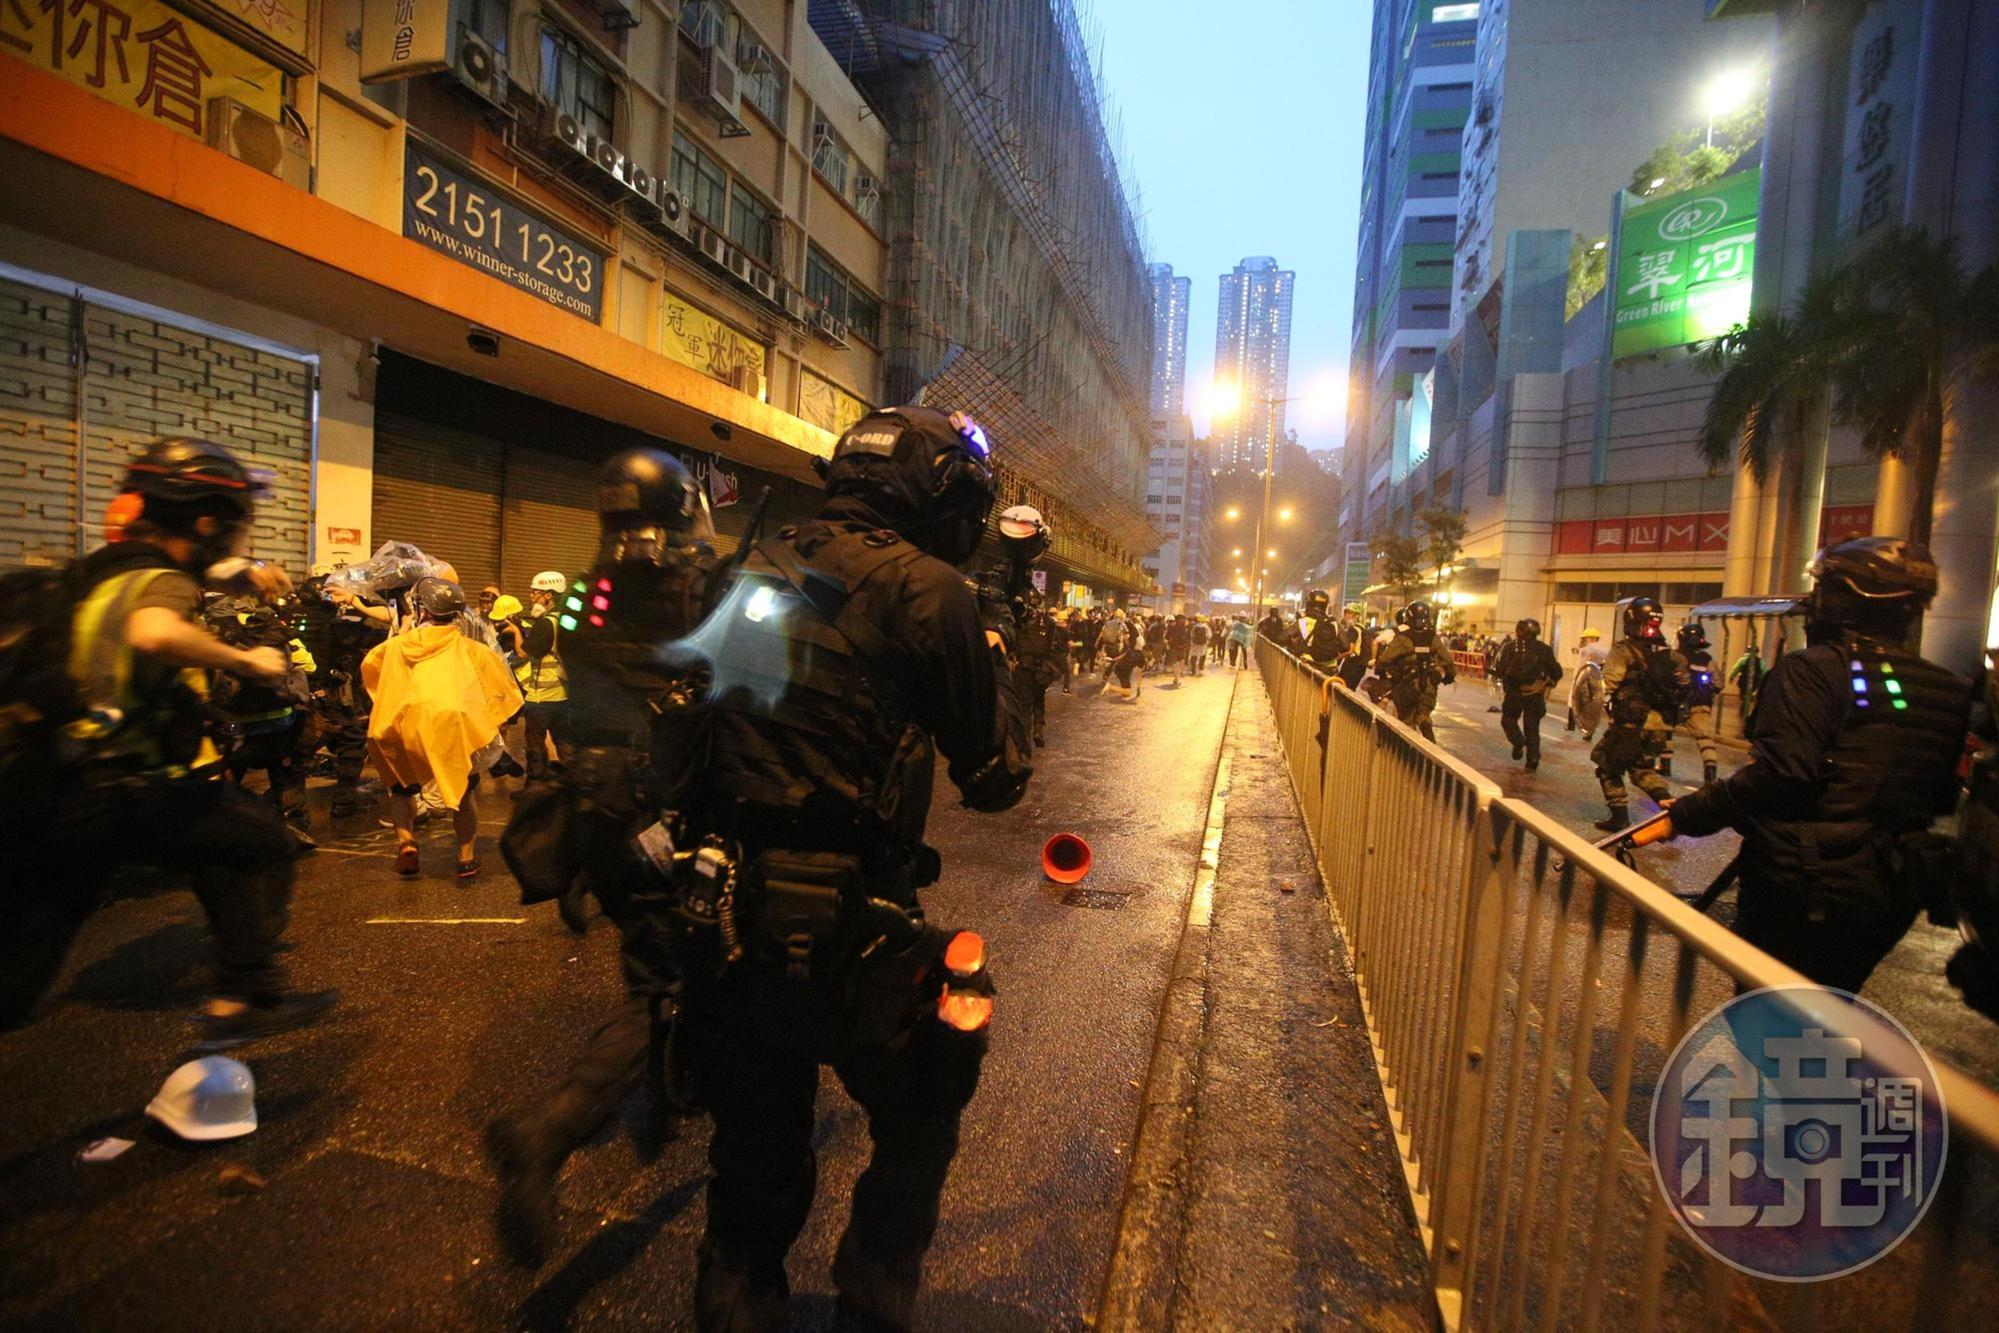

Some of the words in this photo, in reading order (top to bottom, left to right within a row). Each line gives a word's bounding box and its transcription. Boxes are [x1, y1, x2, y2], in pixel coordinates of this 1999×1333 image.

[415, 166, 501, 249] 2151
[518, 223, 592, 293] 1233
[415, 219, 591, 317] www.winner-storage.com
[1627, 231, 1757, 299] 翠河
[1616, 308, 1648, 323] Green
[1651, 298, 1682, 315] River
